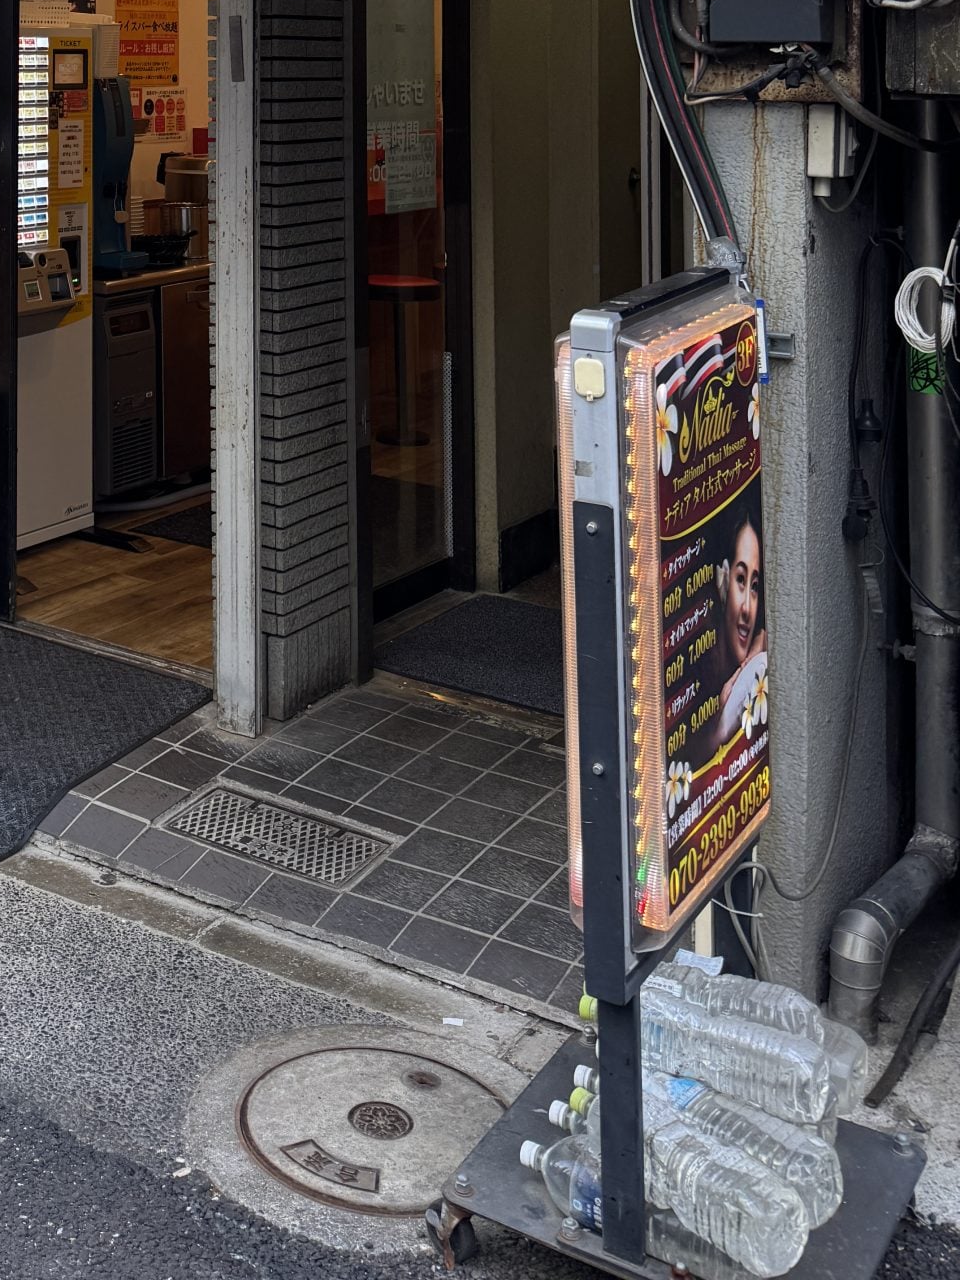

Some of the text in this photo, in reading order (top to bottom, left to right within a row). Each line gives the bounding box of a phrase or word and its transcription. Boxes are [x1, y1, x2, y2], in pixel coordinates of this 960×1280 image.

[59, 39, 82, 48] TICKET
[737, 335, 754, 371] 3F
[679, 384, 734, 464] Nadia
[672, 435, 747, 494] Traditional Thai Massage
[664, 448, 757, 533] ナディア タイ古式マッサージ
[663, 584, 683, 618] 60分
[669, 601, 709, 647] オイルマッサージ
[665, 652, 684, 688] 60分
[671, 680, 696, 717] リラックス
[667, 721, 687, 758] 60分
[669, 765, 770, 907] 070-2399-9933
